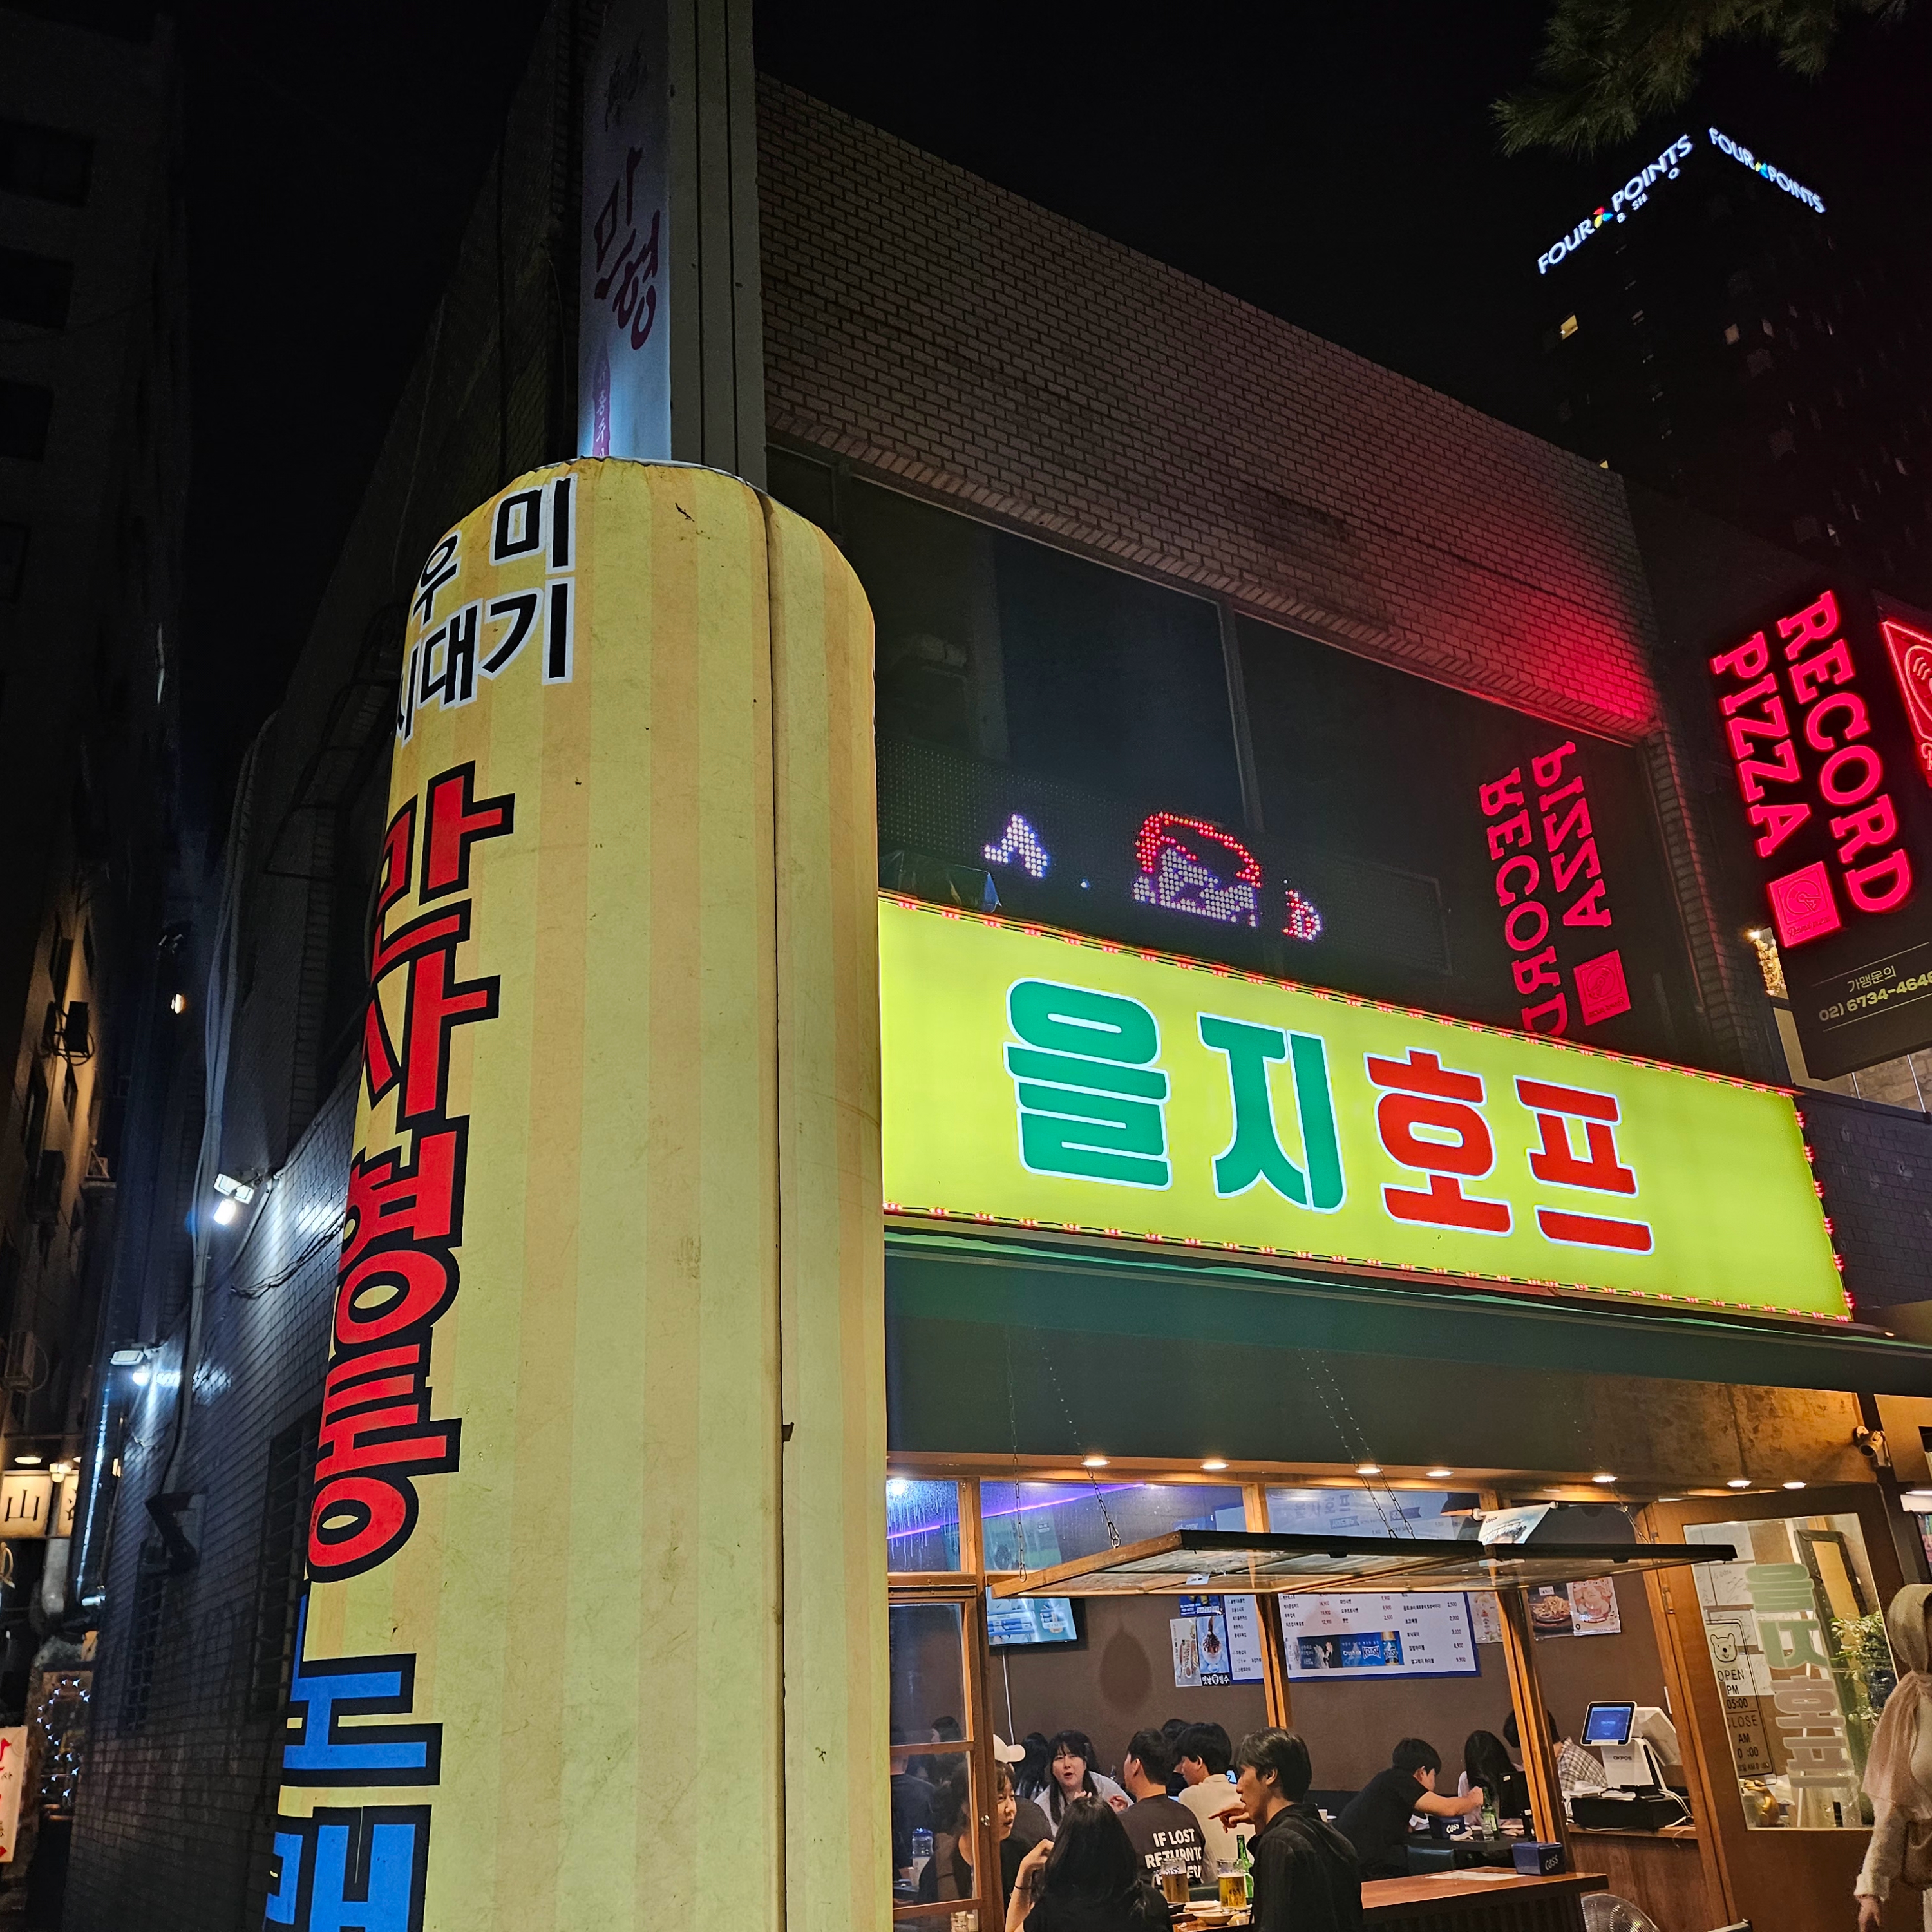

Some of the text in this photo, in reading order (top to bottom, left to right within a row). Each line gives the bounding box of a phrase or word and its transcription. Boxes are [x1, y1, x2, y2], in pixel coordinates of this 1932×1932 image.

[1709, 127, 1826, 213] FOUR POINTS
[1537, 219, 1595, 274] FOUR
[1611, 134, 1693, 212] POINTS
[1712, 631, 1811, 857] PIZZA
[1778, 589, 1912, 913] RECORD
[1847, 965, 1897, 993] 가맹문의
[1819, 1003, 1845, 1021] 02)
[1003, 976, 1655, 1256] 을지호프
[1363, 1646, 1381, 1658] KRUSH
[1717, 1669, 1745, 1681] OPEN
[1726, 1684, 1739, 1695] PM
[1727, 1697, 1748, 1709] 05:00
[1738, 1732, 1751, 1744] AM
[1153, 1828, 1195, 1848] IF LOST
[1446, 1824, 1460, 1834] Cass
[1144, 1846, 1193, 1869] RETURN
[1545, 1855, 1559, 1870] Cass
